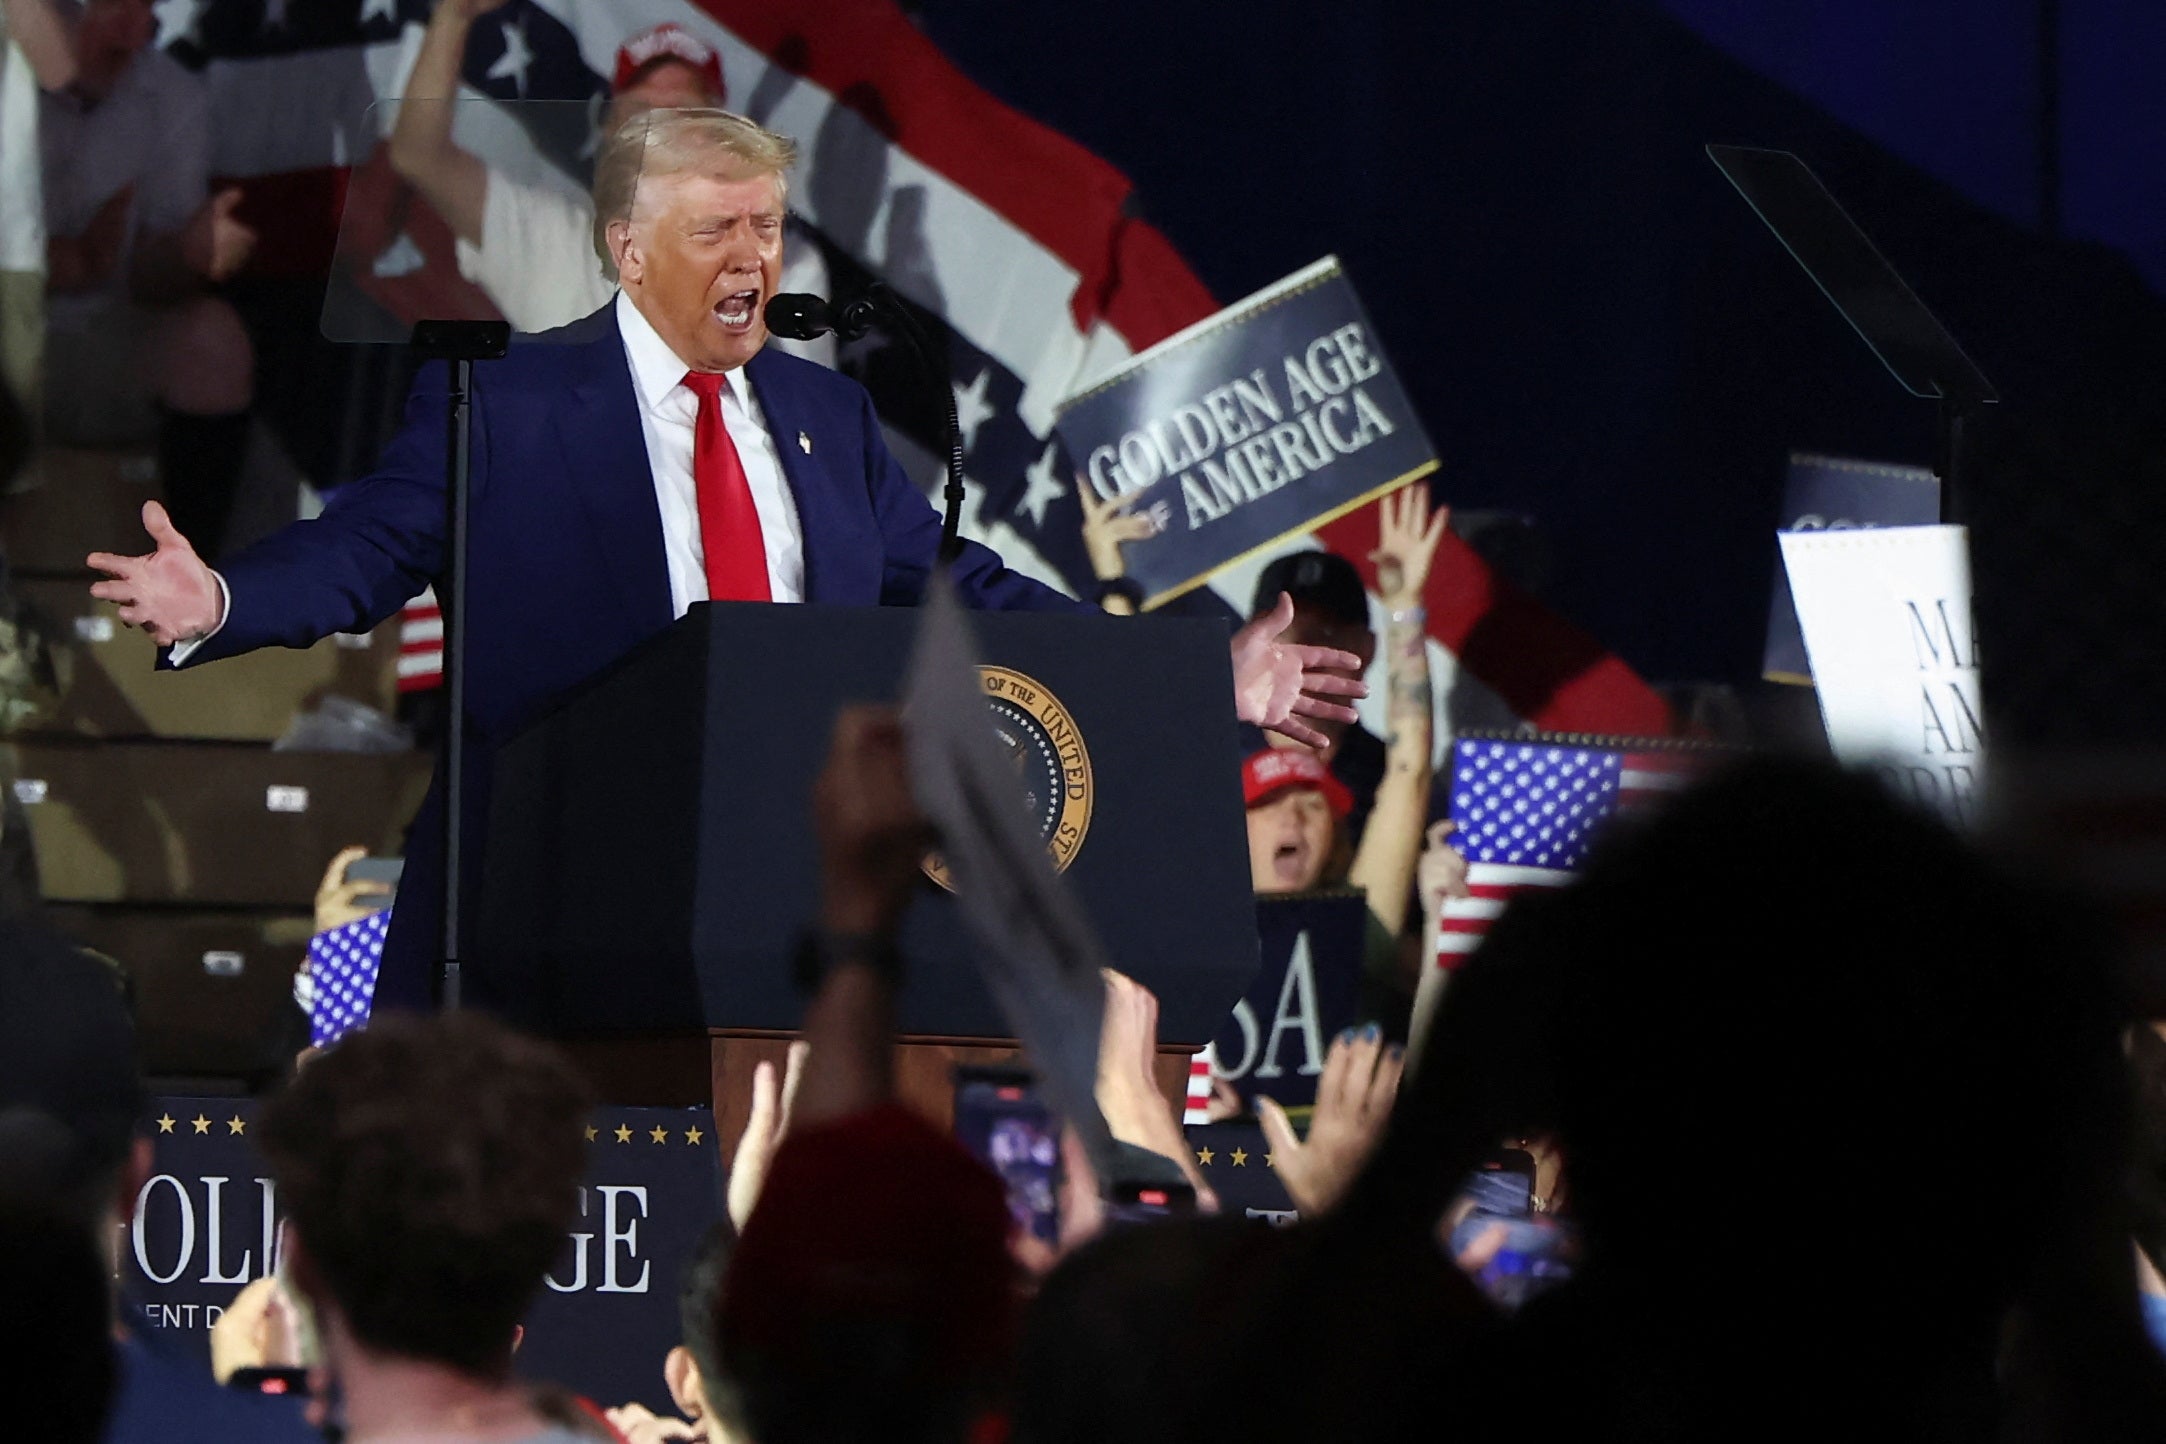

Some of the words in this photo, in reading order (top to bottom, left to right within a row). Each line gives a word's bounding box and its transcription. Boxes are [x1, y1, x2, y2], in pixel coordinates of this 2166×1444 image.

[1089, 367, 1284, 502] GOLDEN
[1283, 322, 1381, 413] AGE
[1180, 387, 1396, 530] AMERICA
[986, 676, 1006, 692] OF
[1009, 681, 1037, 706] THE
[1040, 703, 1085, 801] UNITED
